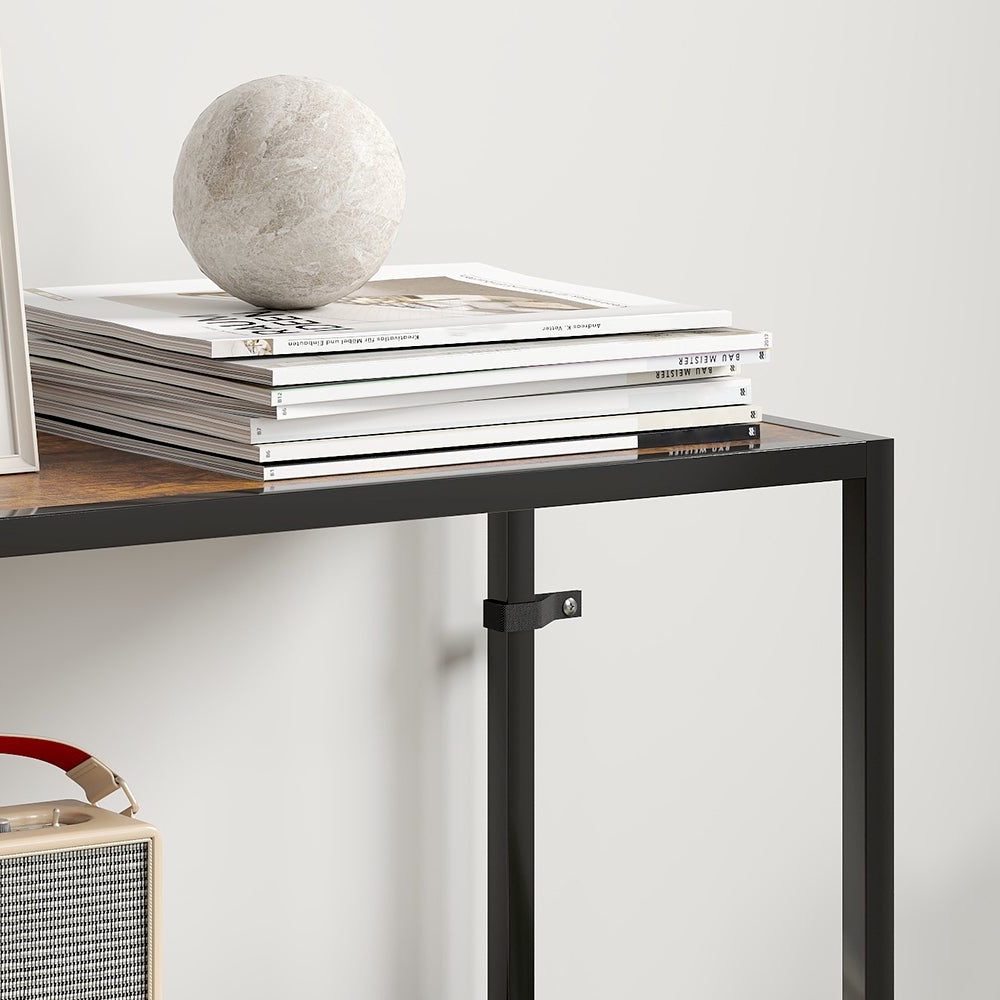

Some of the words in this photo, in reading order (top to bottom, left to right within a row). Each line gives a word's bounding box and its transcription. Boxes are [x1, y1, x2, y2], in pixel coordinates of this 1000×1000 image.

[325, 339, 340, 347] und
[341, 337, 363, 346] Möbel
[364, 336, 375, 345] für
[376, 334, 420, 344] Kreativatlas
[287, 340, 324, 348] Einbauten
[678, 354, 718, 366] MEISTER
[721, 353, 741, 362] BAU
[655, 368, 691, 379] MEISTER
[695, 366, 713, 374] BAU
